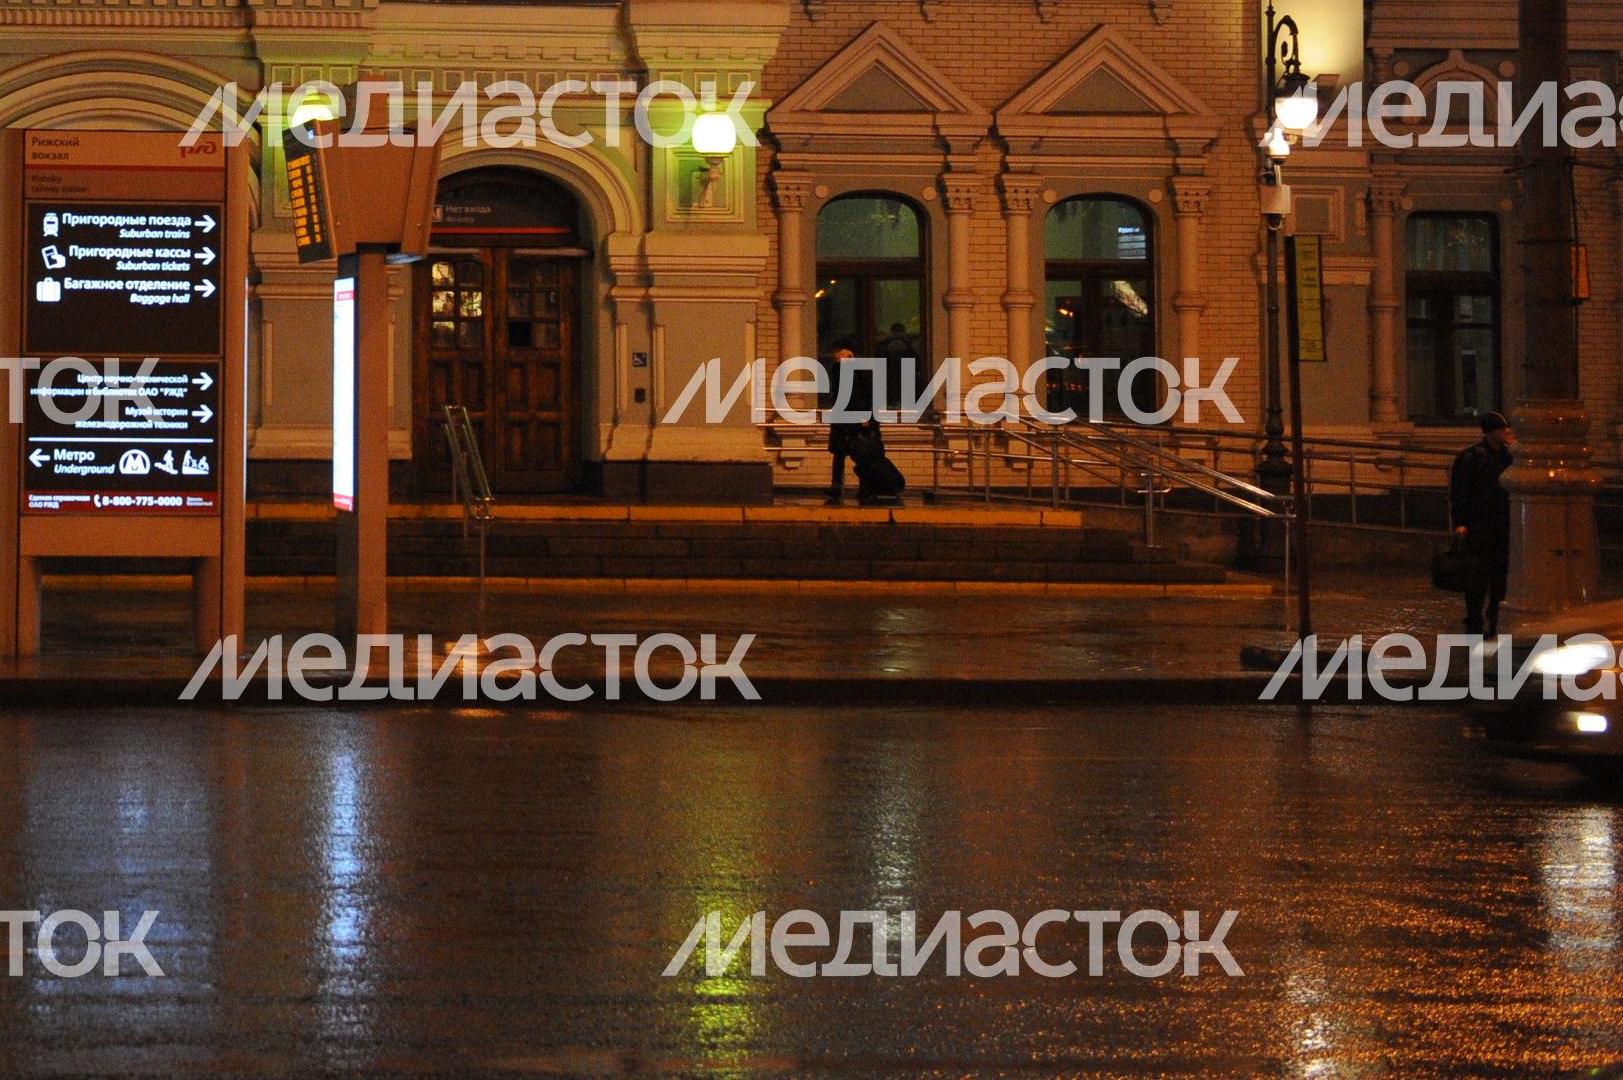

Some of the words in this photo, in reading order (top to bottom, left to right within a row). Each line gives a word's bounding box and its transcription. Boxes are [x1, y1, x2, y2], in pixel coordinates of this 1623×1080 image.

[32, 136, 80, 147] Рижский
[32, 152, 69, 160] вокзал
[62, 212, 147, 228] Пригородные
[148, 215, 192, 227] поезда
[119, 229, 164, 239] Suburban
[165, 229, 191, 239] trains
[69, 245, 154, 260] Пригородные
[155, 248, 191, 258] кассы
[116, 261, 161, 271] Suburban
[162, 261, 191, 271] tickets
[64, 277, 124, 291] Багажное
[125, 280, 191, 292] отделение
[130, 293, 173, 305] Baggage
[173, 293, 190, 303] hall
[77, 374, 104, 384] Центр
[138, 388, 159, 396] ОАО
[125, 406, 152, 418] Музей
[54, 449, 95, 462] Метро
[54, 463, 115, 476] Underground
[102, 496, 183, 506] 8-800-775-0000
